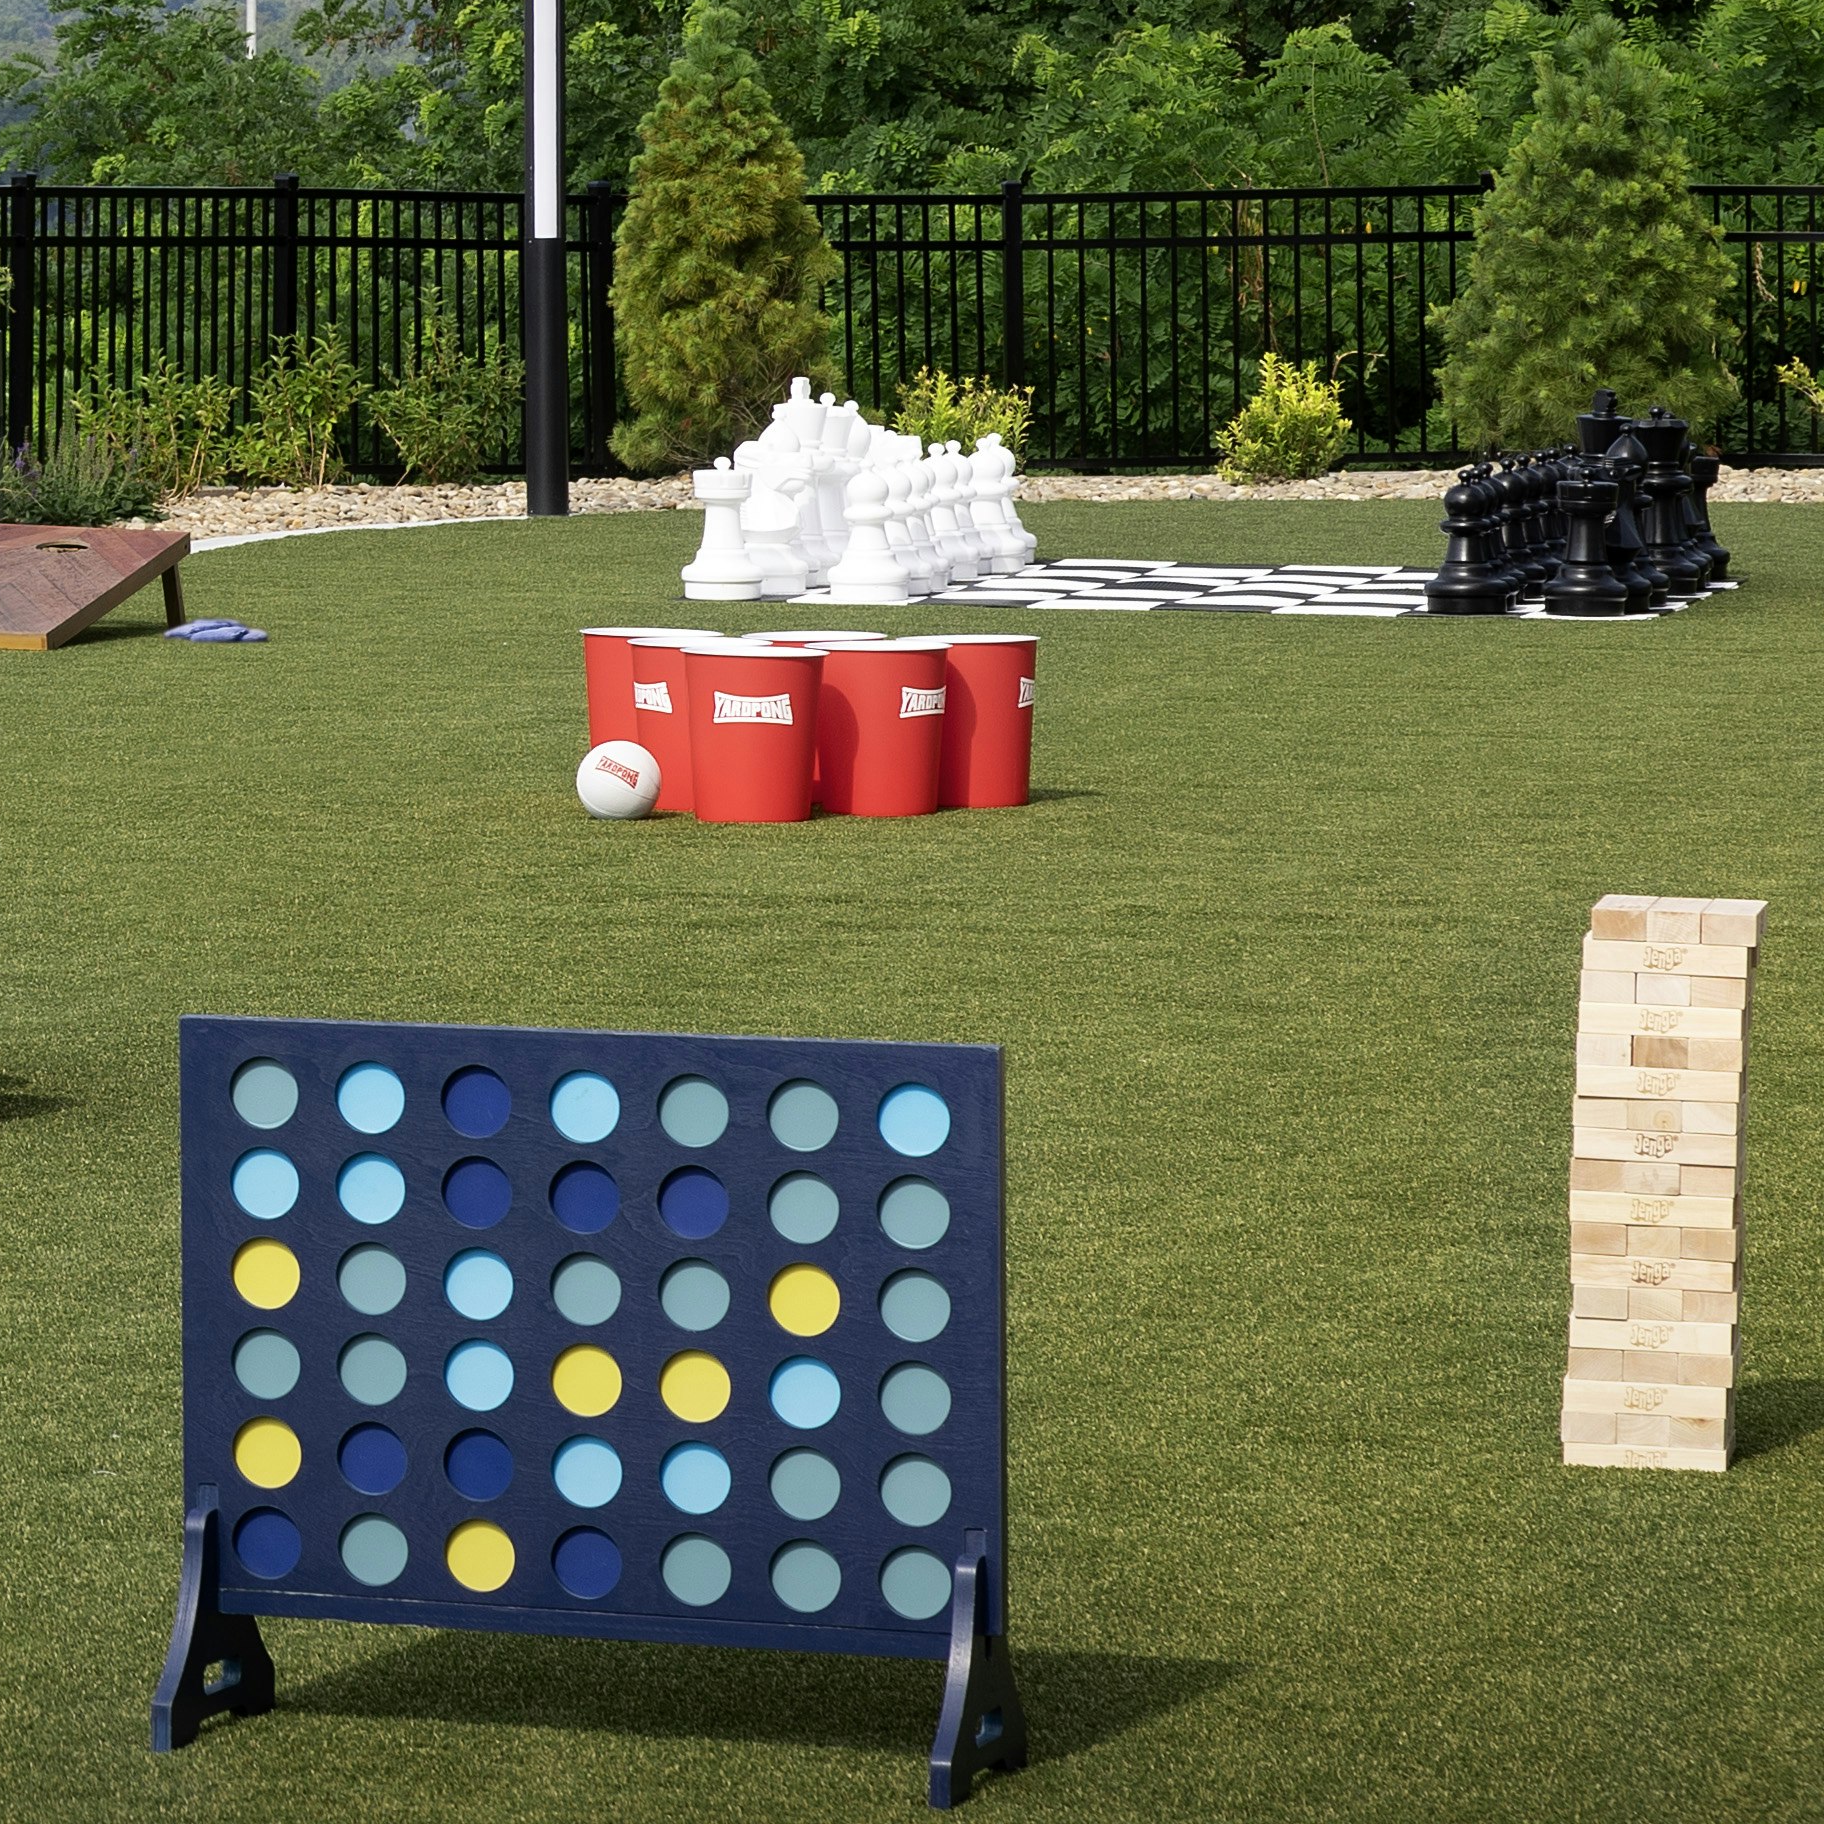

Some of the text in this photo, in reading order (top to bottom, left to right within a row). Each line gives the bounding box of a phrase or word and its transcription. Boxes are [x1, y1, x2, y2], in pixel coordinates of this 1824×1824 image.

[713, 695, 793, 721] YARDPONG
[1643, 946, 1683, 971] Jenga
[1639, 1009, 1679, 1034] Jenga
[1637, 1071, 1676, 1096] Jenga
[1634, 1133, 1674, 1158] Jenga
[1631, 1199, 1670, 1223] Jenga
[1631, 1261, 1671, 1286] Jenga
[1630, 1324, 1669, 1349] Jenga
[1624, 1386, 1664, 1411] Jenga
